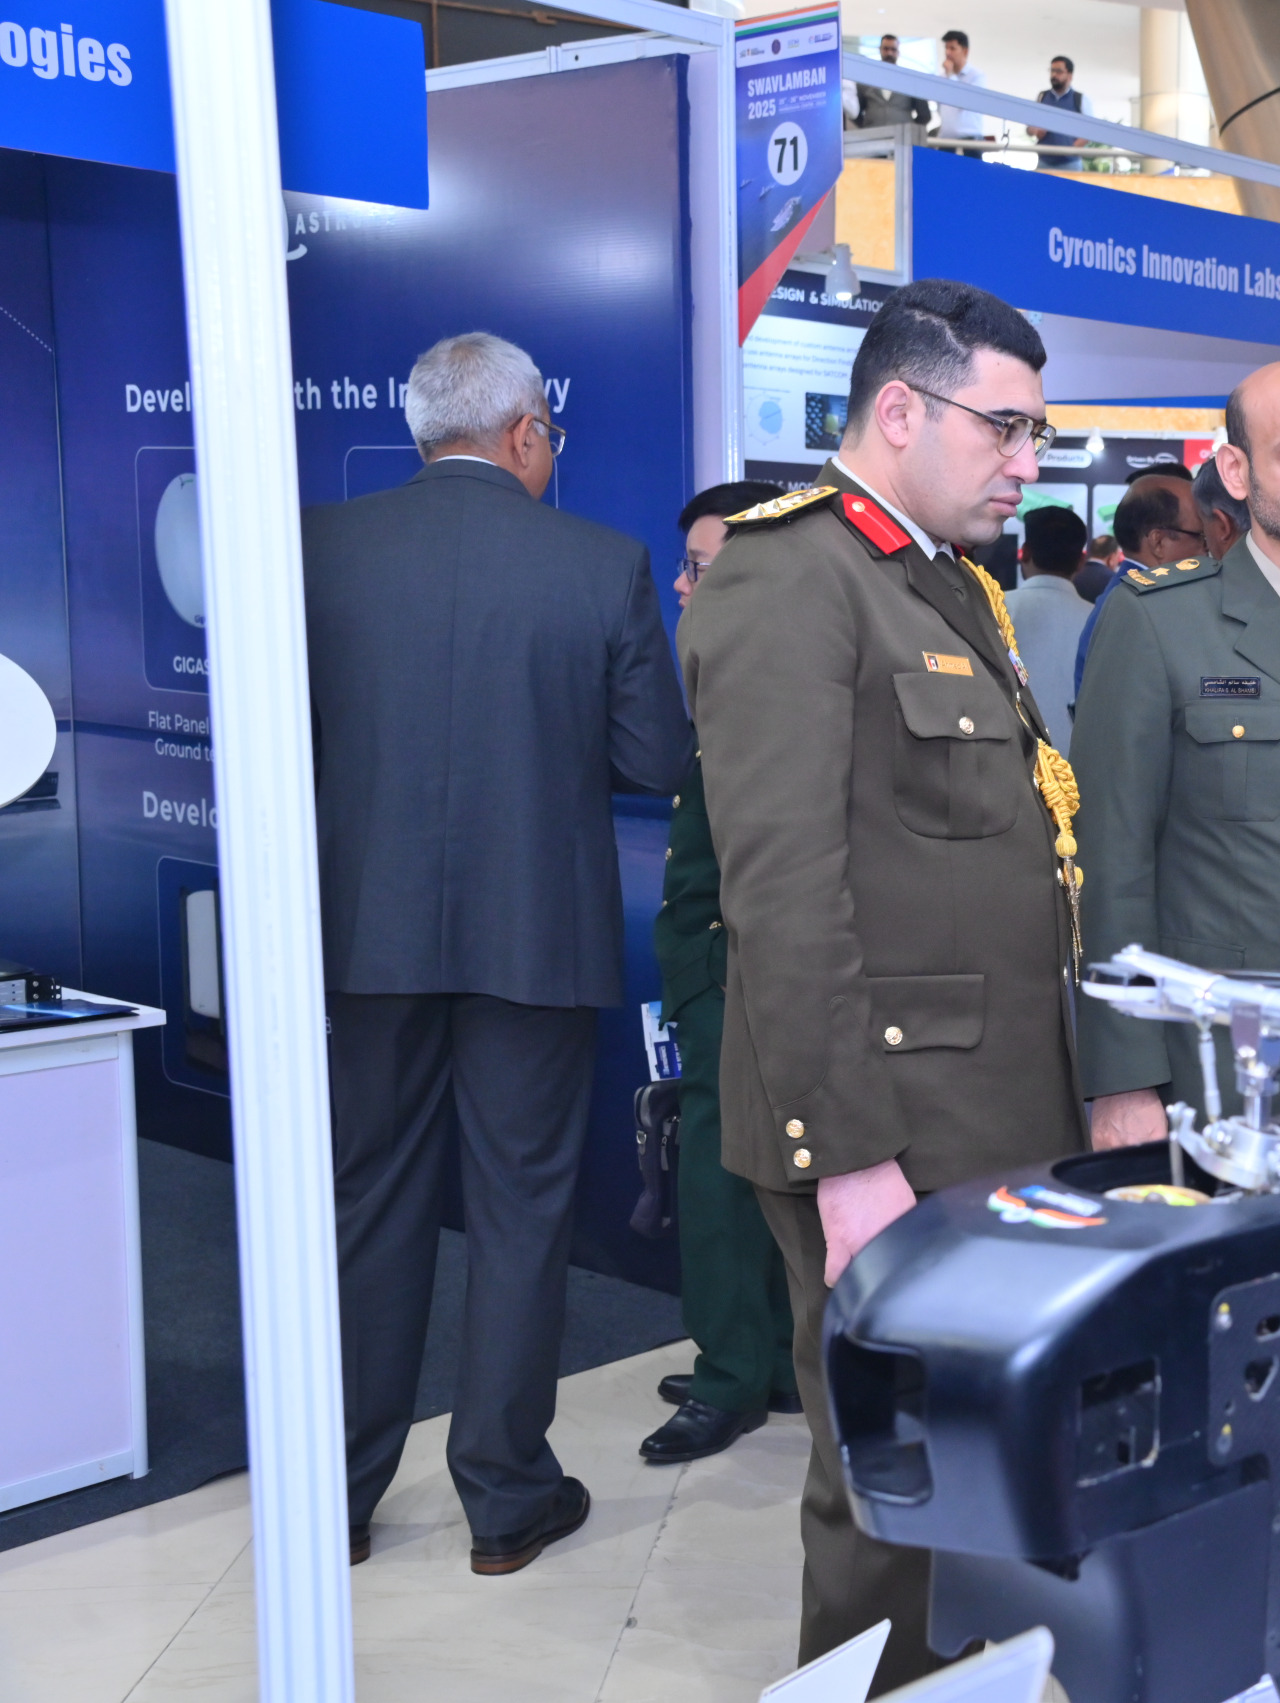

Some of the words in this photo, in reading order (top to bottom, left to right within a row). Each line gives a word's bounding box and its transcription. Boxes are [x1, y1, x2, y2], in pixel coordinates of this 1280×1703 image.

[0, 21, 133, 87] ogies
[747, 66, 827, 98] SWAVLAMBAN
[748, 98, 776, 120] 2025
[774, 136, 799, 174] 71
[1049, 226, 1137, 276] Cyronics
[1142, 244, 1239, 294] Innovation
[770, 285, 805, 303] ESIGN
[809, 289, 819, 305] &
[125, 381, 191, 413] Devel
[331, 376, 378, 409] the
[149, 710, 172, 731] Flat
[175, 713, 210, 735] Panel
[155, 738, 202, 761] Ground
[143, 790, 217, 830] Develo
